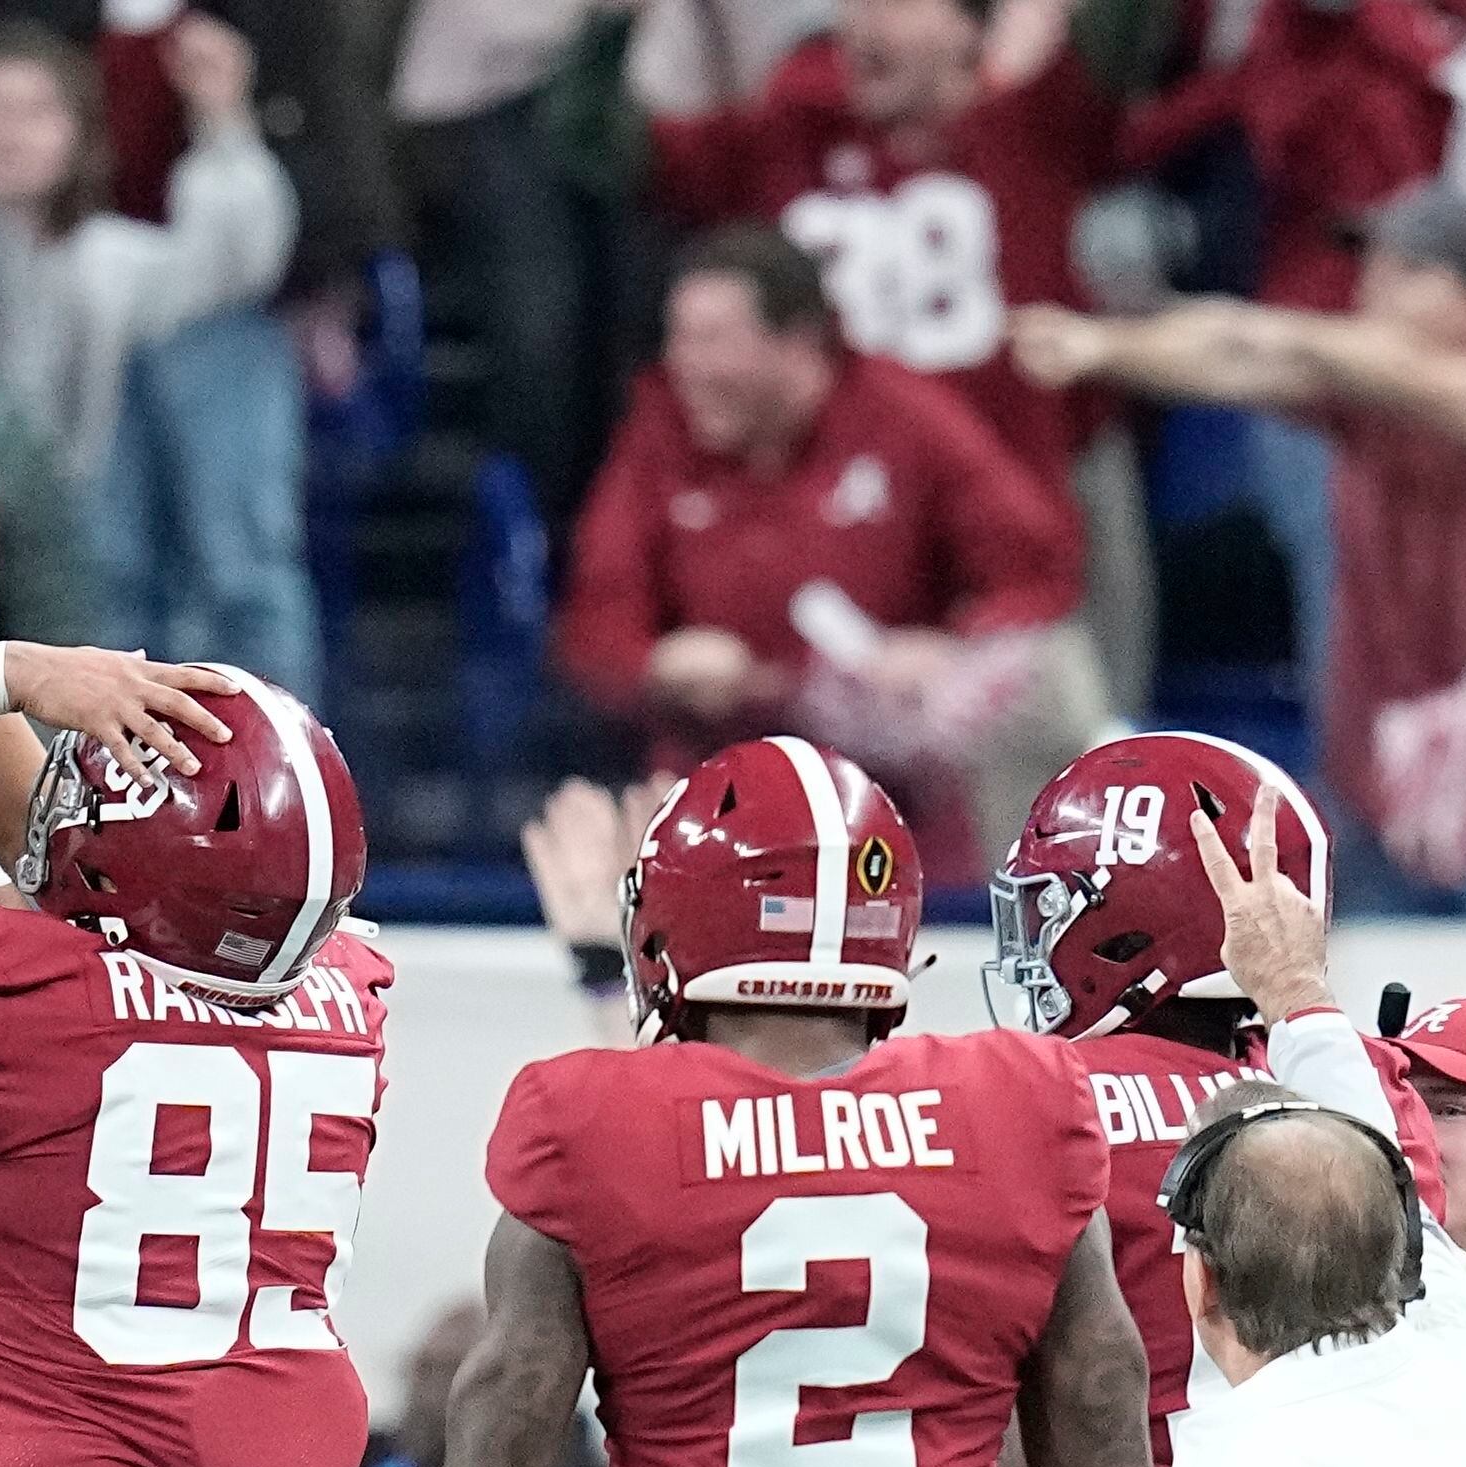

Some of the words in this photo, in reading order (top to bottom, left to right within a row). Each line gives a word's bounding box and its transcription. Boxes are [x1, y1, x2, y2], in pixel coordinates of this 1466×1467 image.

[1094, 785, 1166, 866] 19
[99, 952, 368, 1036] RANOLPH
[736, 979, 845, 998] CRIMSON
[702, 1089, 954, 1180] MILROE
[73, 1041, 377, 1366] 85
